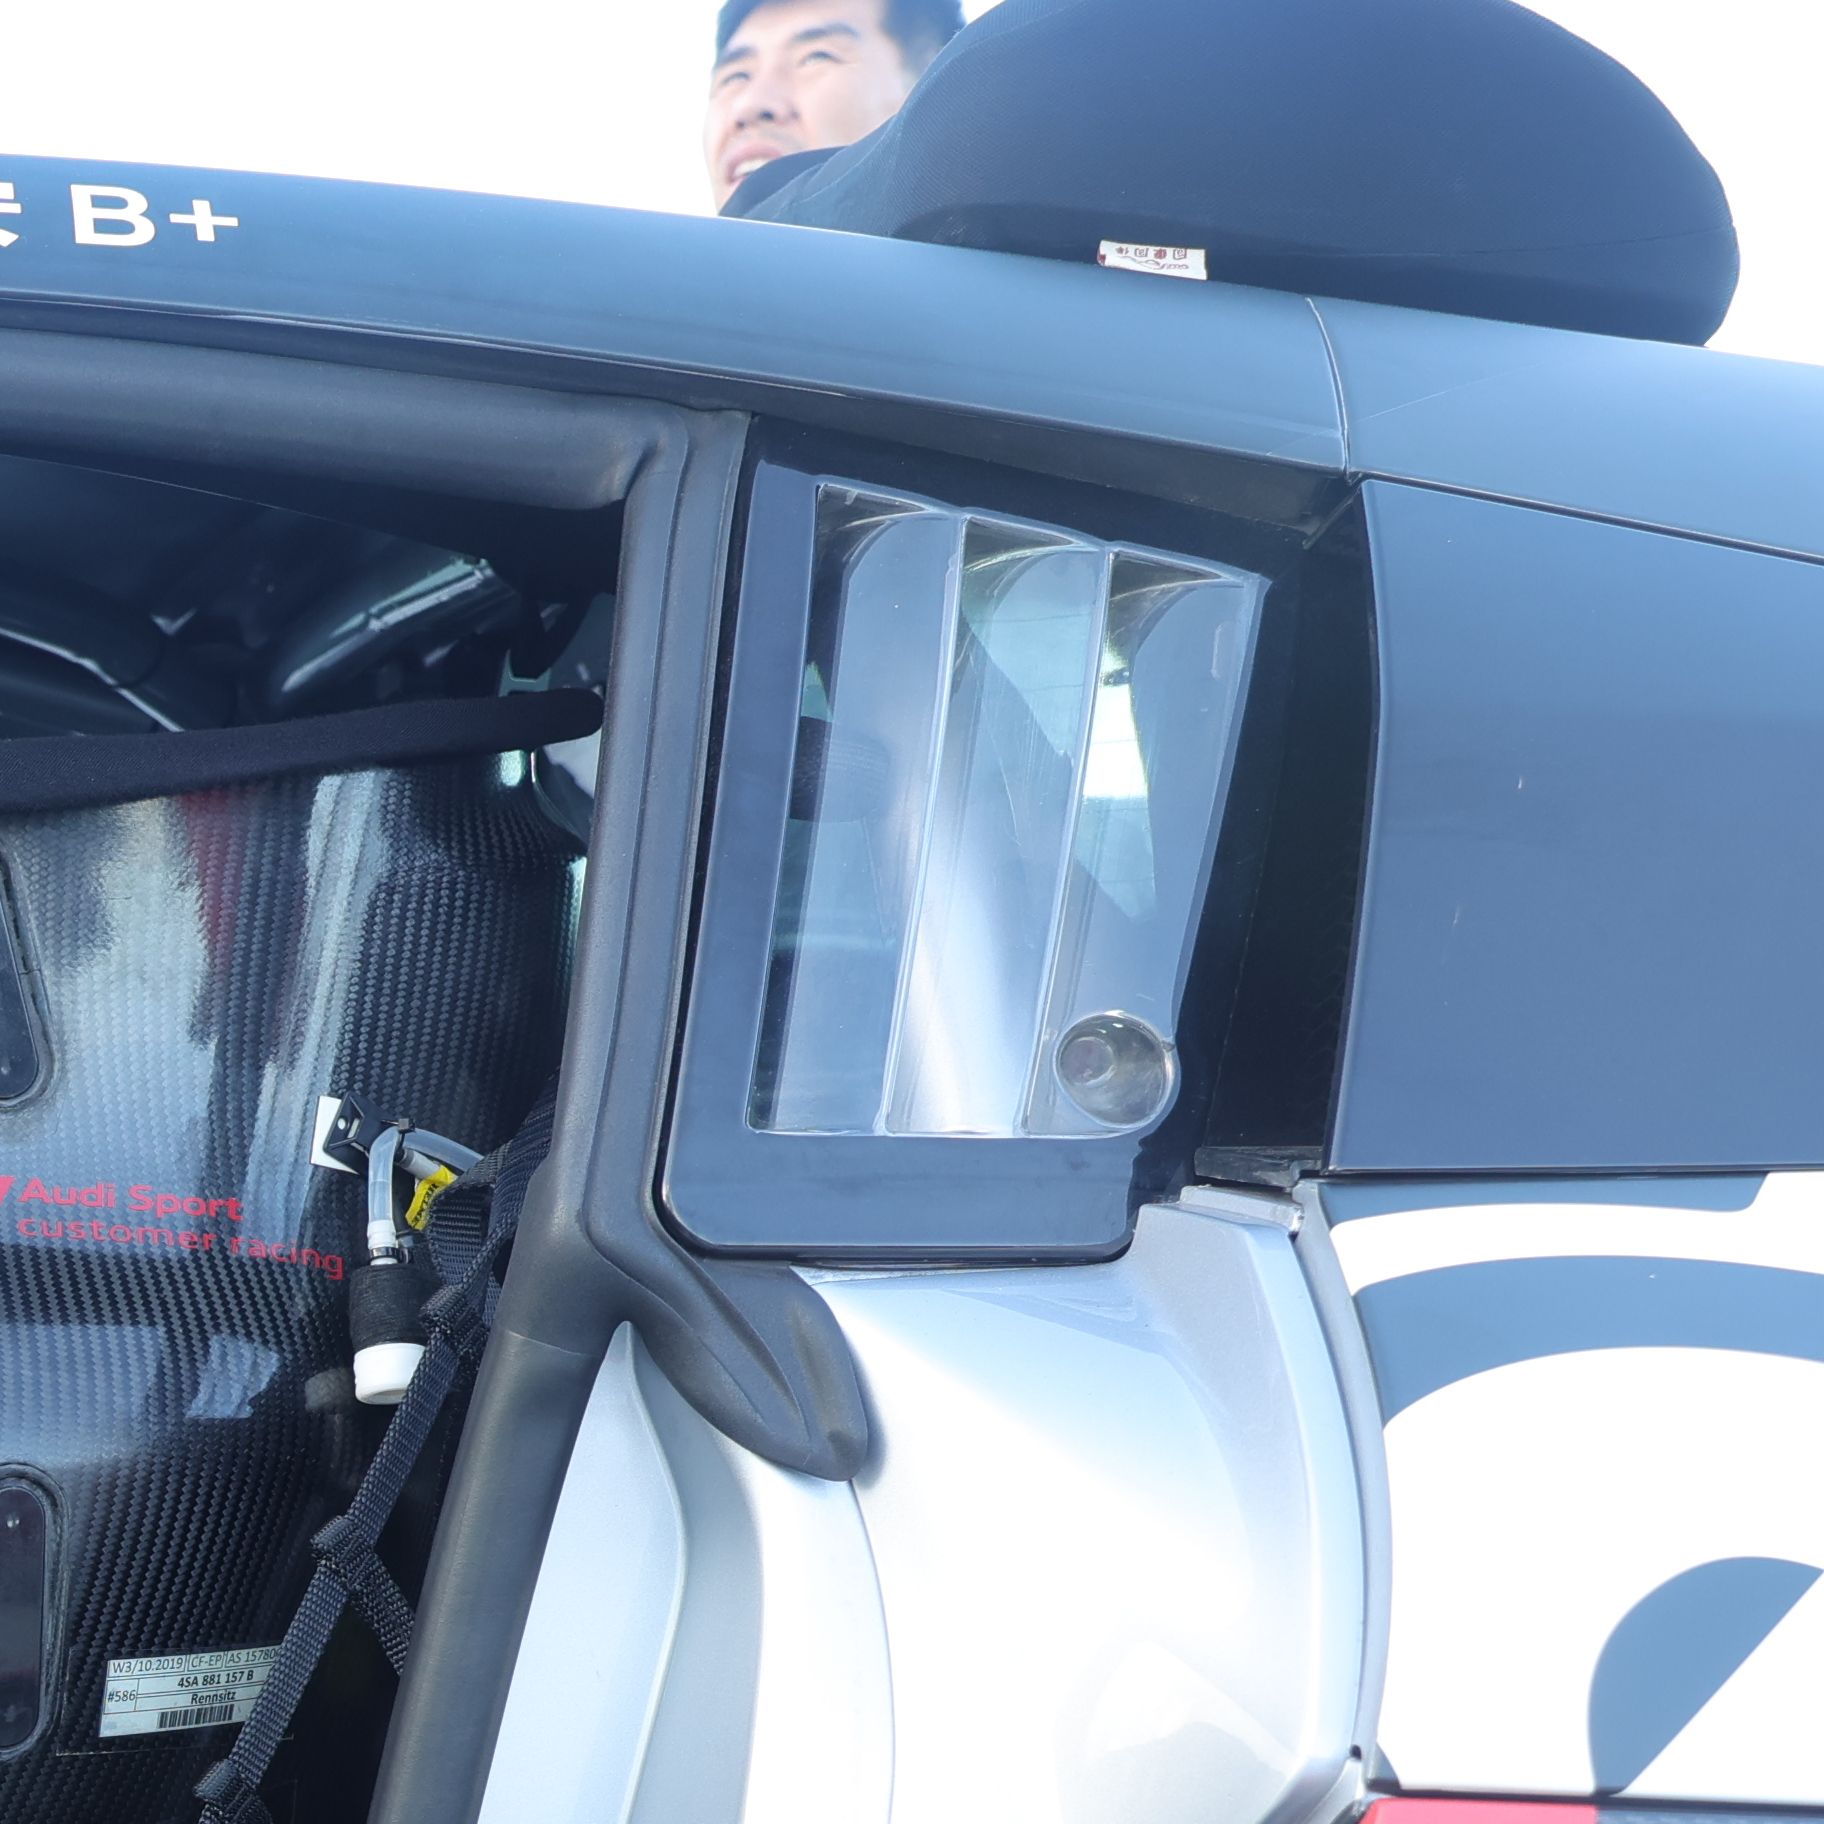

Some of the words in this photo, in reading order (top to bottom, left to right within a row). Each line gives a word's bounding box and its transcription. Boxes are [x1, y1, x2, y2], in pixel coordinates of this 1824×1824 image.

[70, 183, 240, 247] B+
[19, 1177, 116, 1208] Audi
[128, 1185, 244, 1221] Sport
[17, 1218, 217, 1251] customer
[230, 1235, 344, 1280] racing
[112, 1657, 183, 1673] W3/10.2019
[191, 1653, 222, 1668] CF-EP
[228, 1652, 242, 1664] AS
[202, 1674, 221, 1686] 881
[225, 1671, 243, 1683] 157
[247, 1670, 254, 1681] B
[107, 1689, 136, 1702] #586
[191, 1691, 236, 1705] Rennsitz
